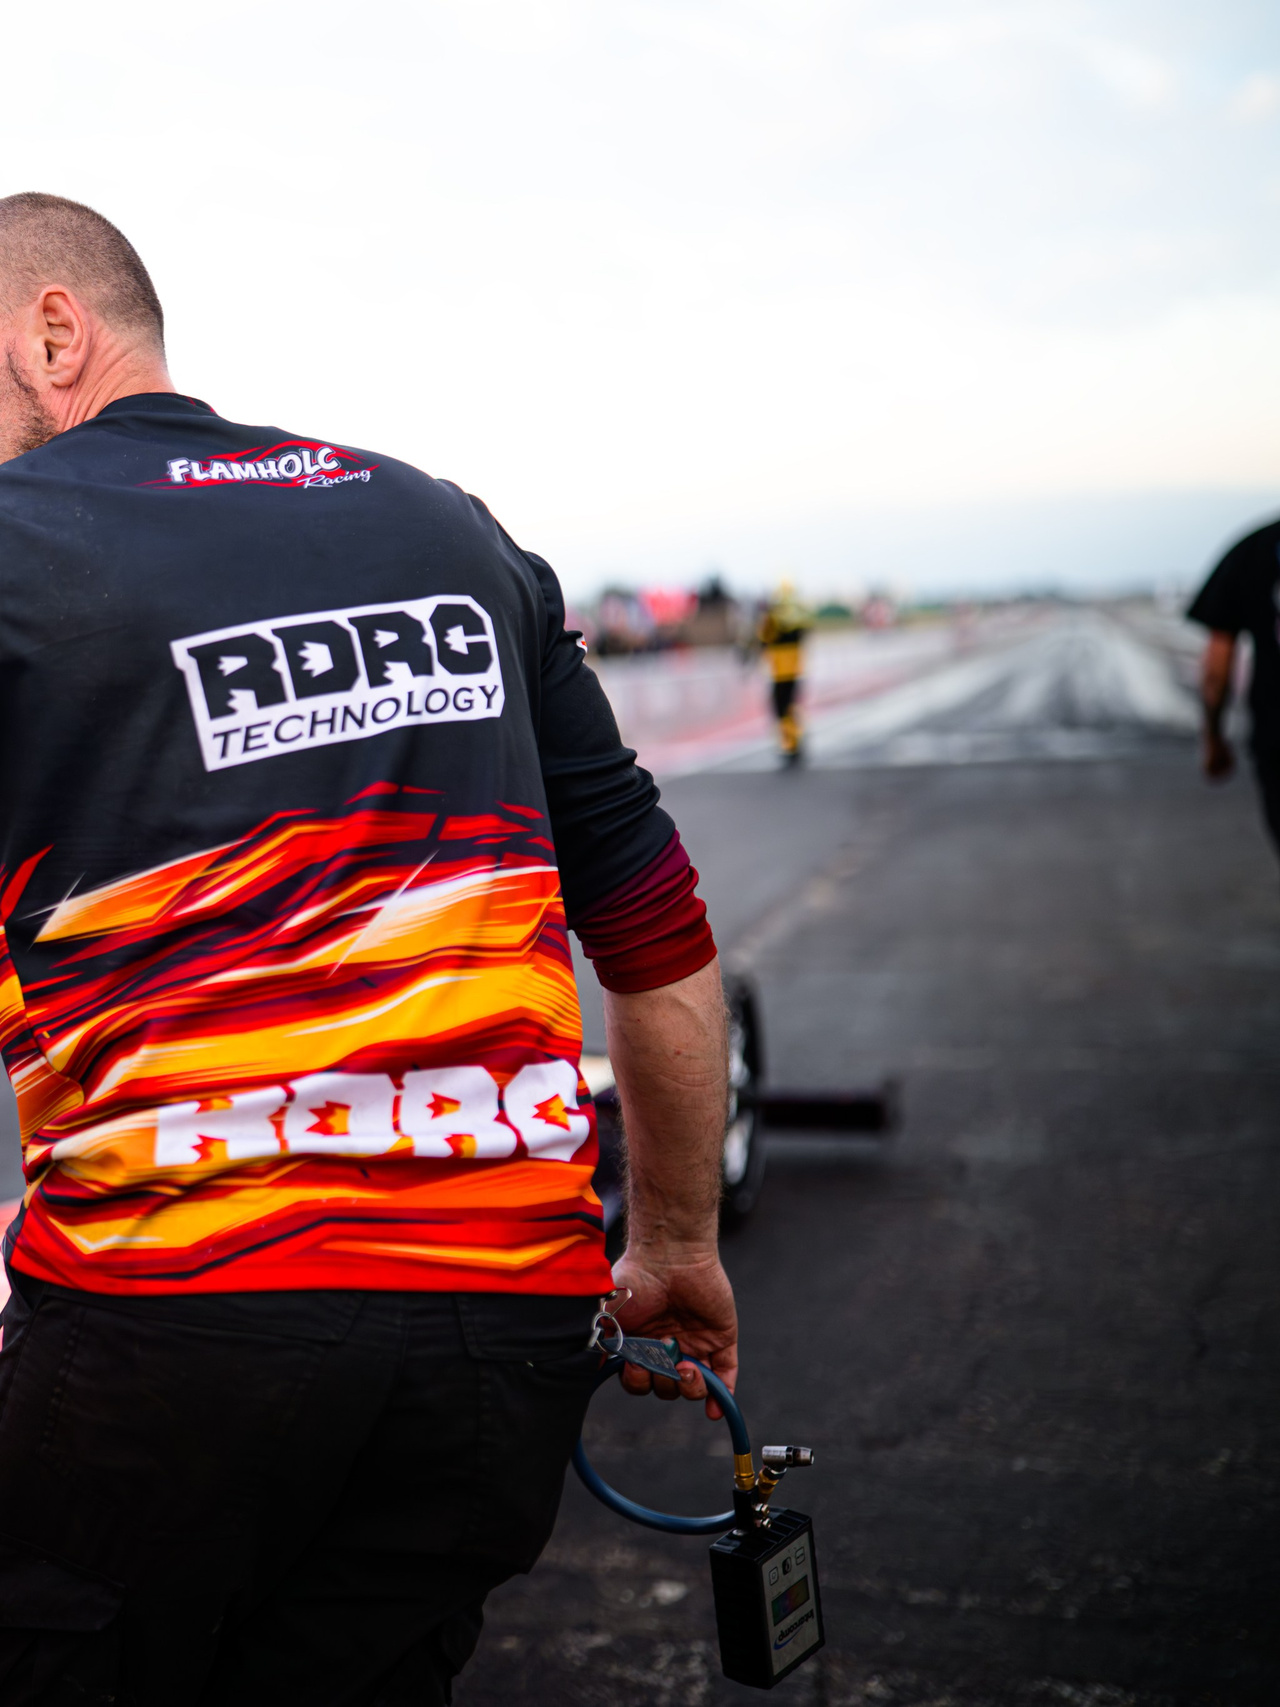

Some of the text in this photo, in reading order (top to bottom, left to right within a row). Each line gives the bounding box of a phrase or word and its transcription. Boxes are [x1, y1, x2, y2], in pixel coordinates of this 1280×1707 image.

[168, 447, 340, 483] FLAMHOLC
[296, 470, 371, 489] Racing
[187, 603, 494, 721] RDRC
[212, 685, 498, 759] TECHNOLOGY
